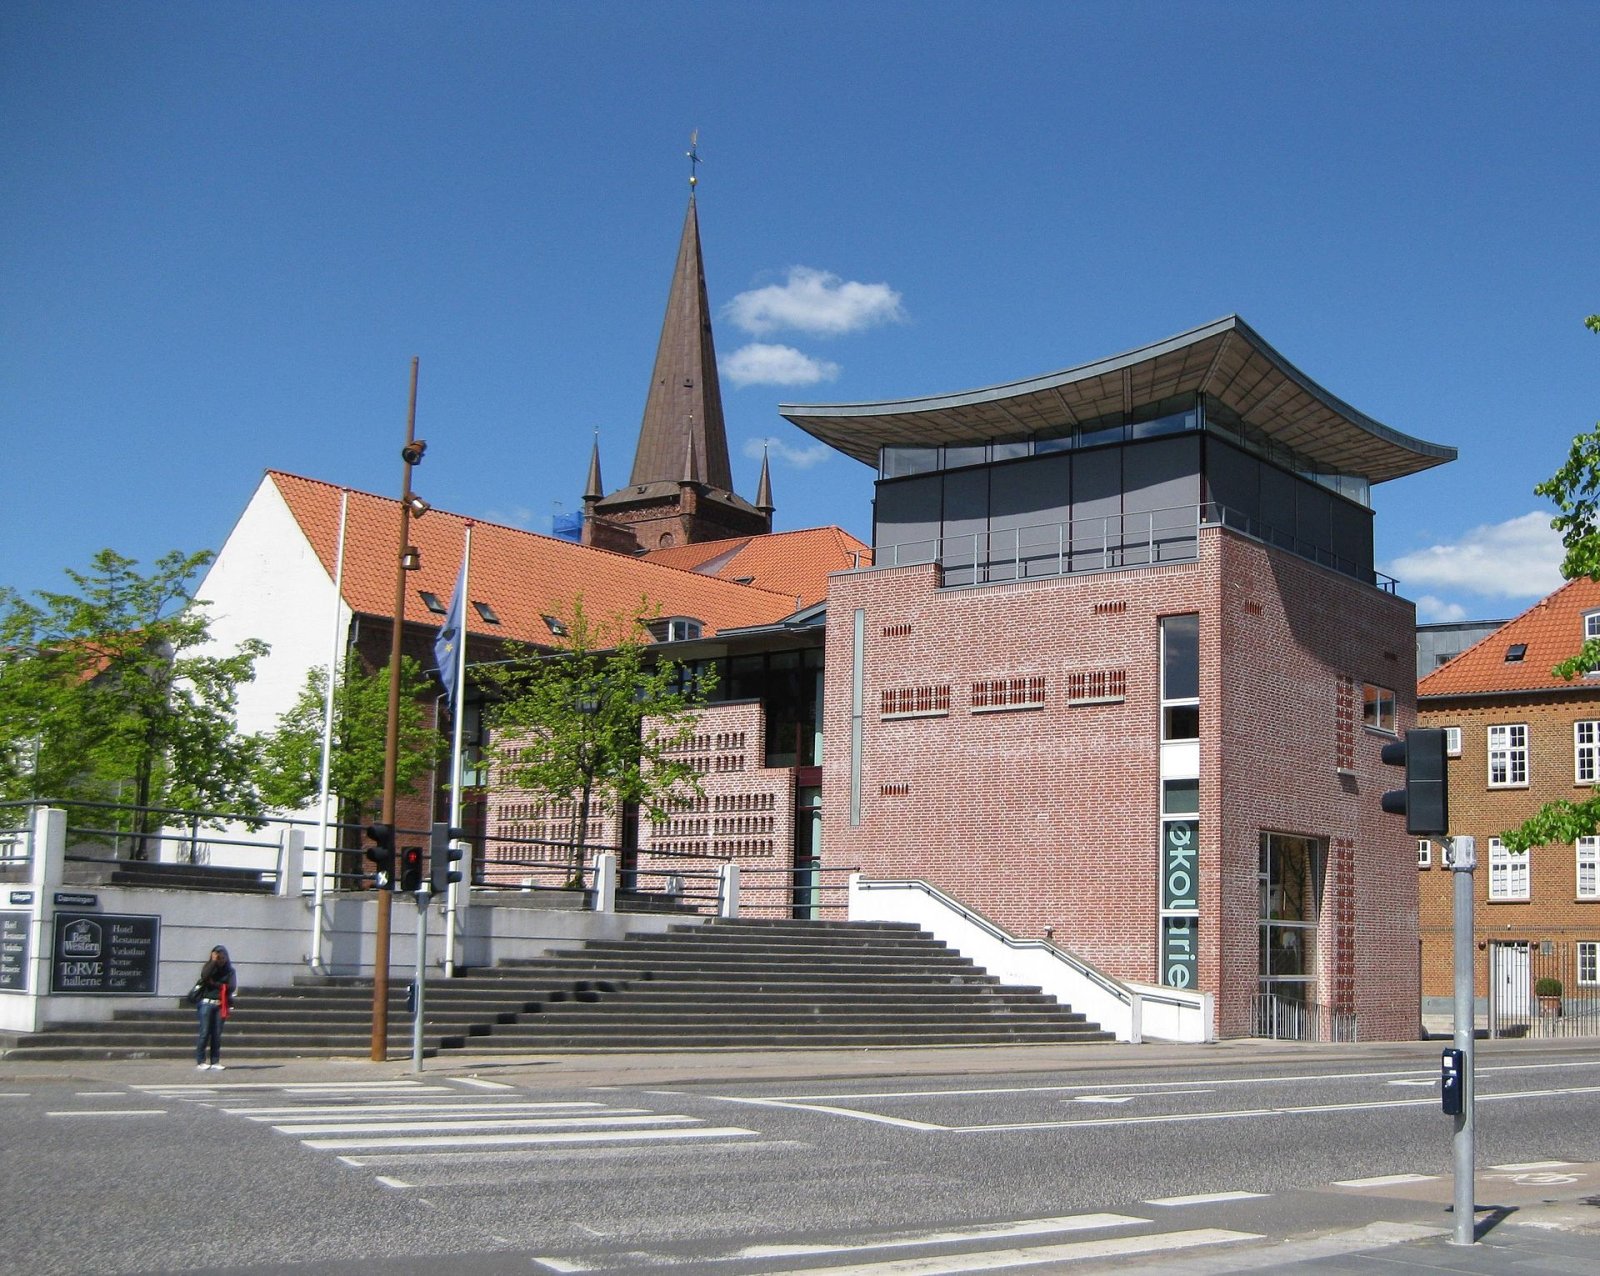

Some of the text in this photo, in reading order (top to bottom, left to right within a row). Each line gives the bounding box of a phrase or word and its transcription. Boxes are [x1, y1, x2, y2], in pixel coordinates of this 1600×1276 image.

[112, 924, 134, 934] Hotel
[73, 932, 91, 942] Best
[112, 935, 151, 944] Restaurant
[64, 940, 100, 951] Western
[63, 976, 102, 986] hallerne
